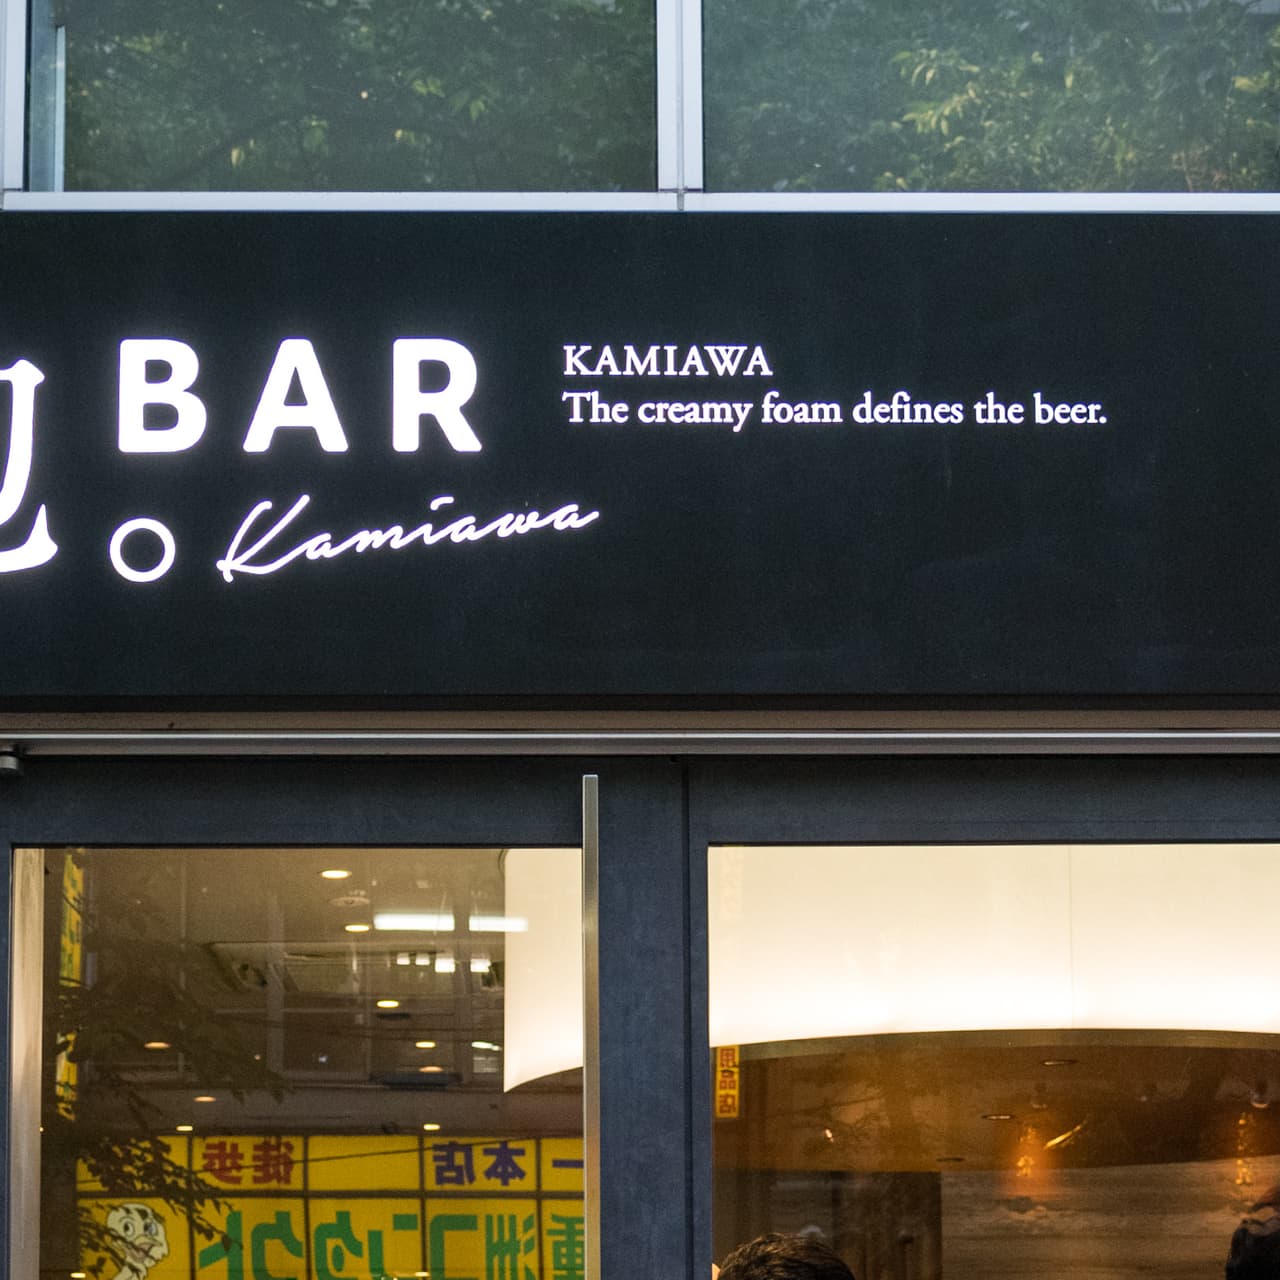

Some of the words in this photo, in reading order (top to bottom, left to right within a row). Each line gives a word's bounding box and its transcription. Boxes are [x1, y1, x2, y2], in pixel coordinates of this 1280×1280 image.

[563, 345, 773, 376] KAMIAWA
[118, 339, 482, 453] BAR
[562, 391, 629, 423] The
[638, 402, 753, 432] creamy
[762, 391, 843, 423] foam
[853, 391, 963, 423] defines
[974, 392, 1024, 423] the
[1033, 392, 1106, 424] beer.
[216, 495, 599, 582] Kamiawa
